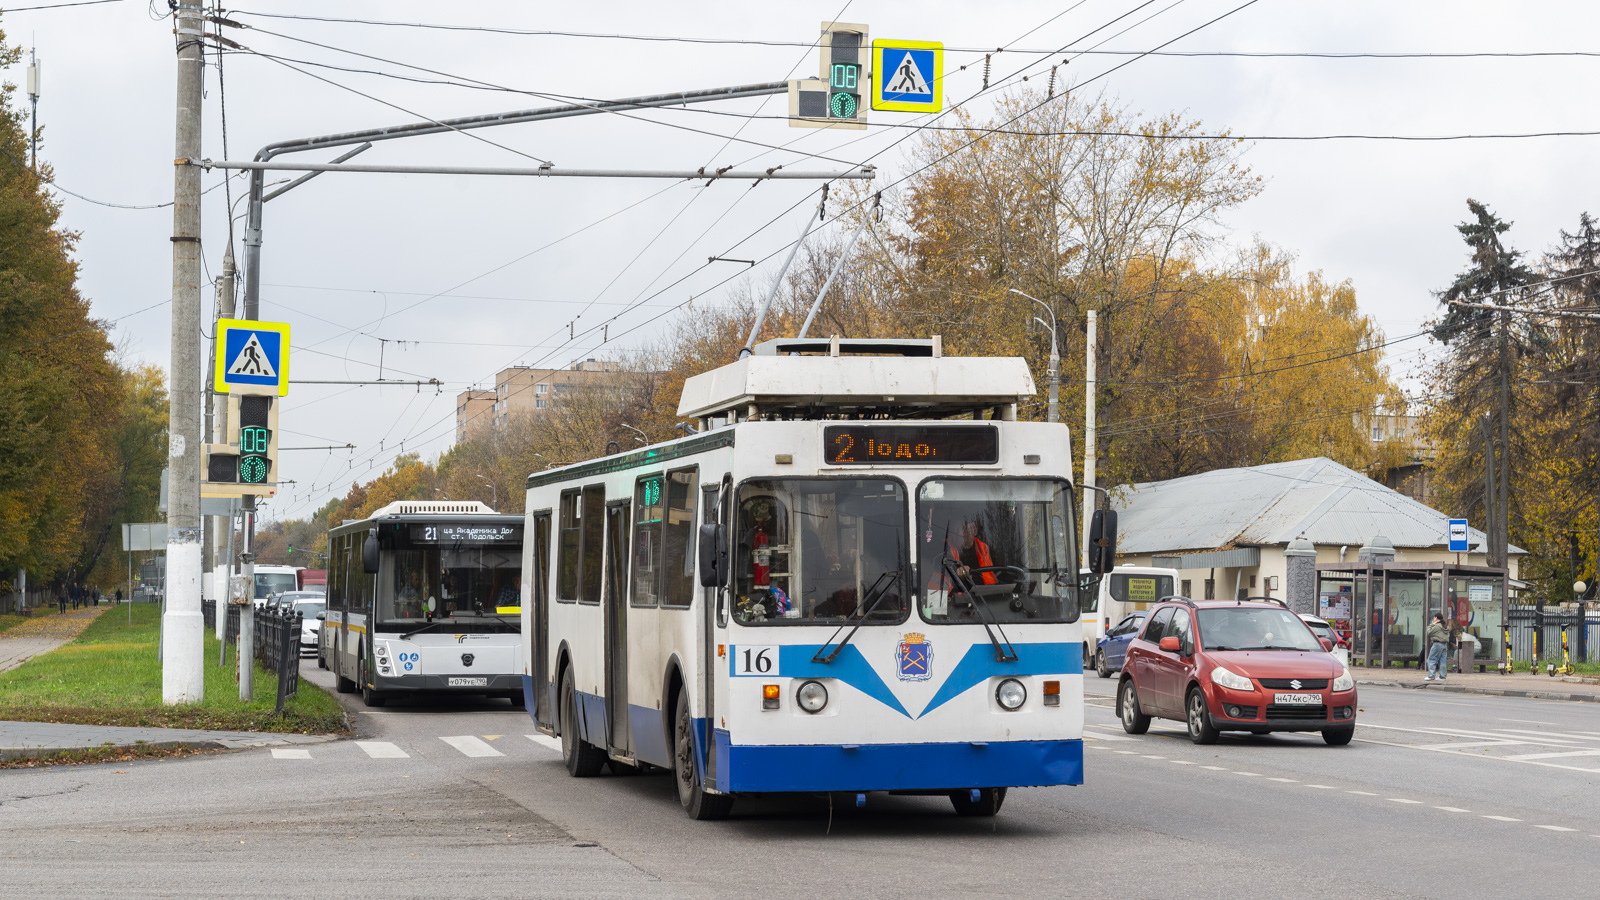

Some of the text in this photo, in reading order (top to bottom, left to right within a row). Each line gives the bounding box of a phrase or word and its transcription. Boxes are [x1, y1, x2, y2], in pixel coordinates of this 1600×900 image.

[831, 64, 857, 88] 108
[240, 428, 267, 453] 108
[835, 434, 854, 462] 2
[425, 527, 437, 540] 21
[743, 647, 772, 673] 16
